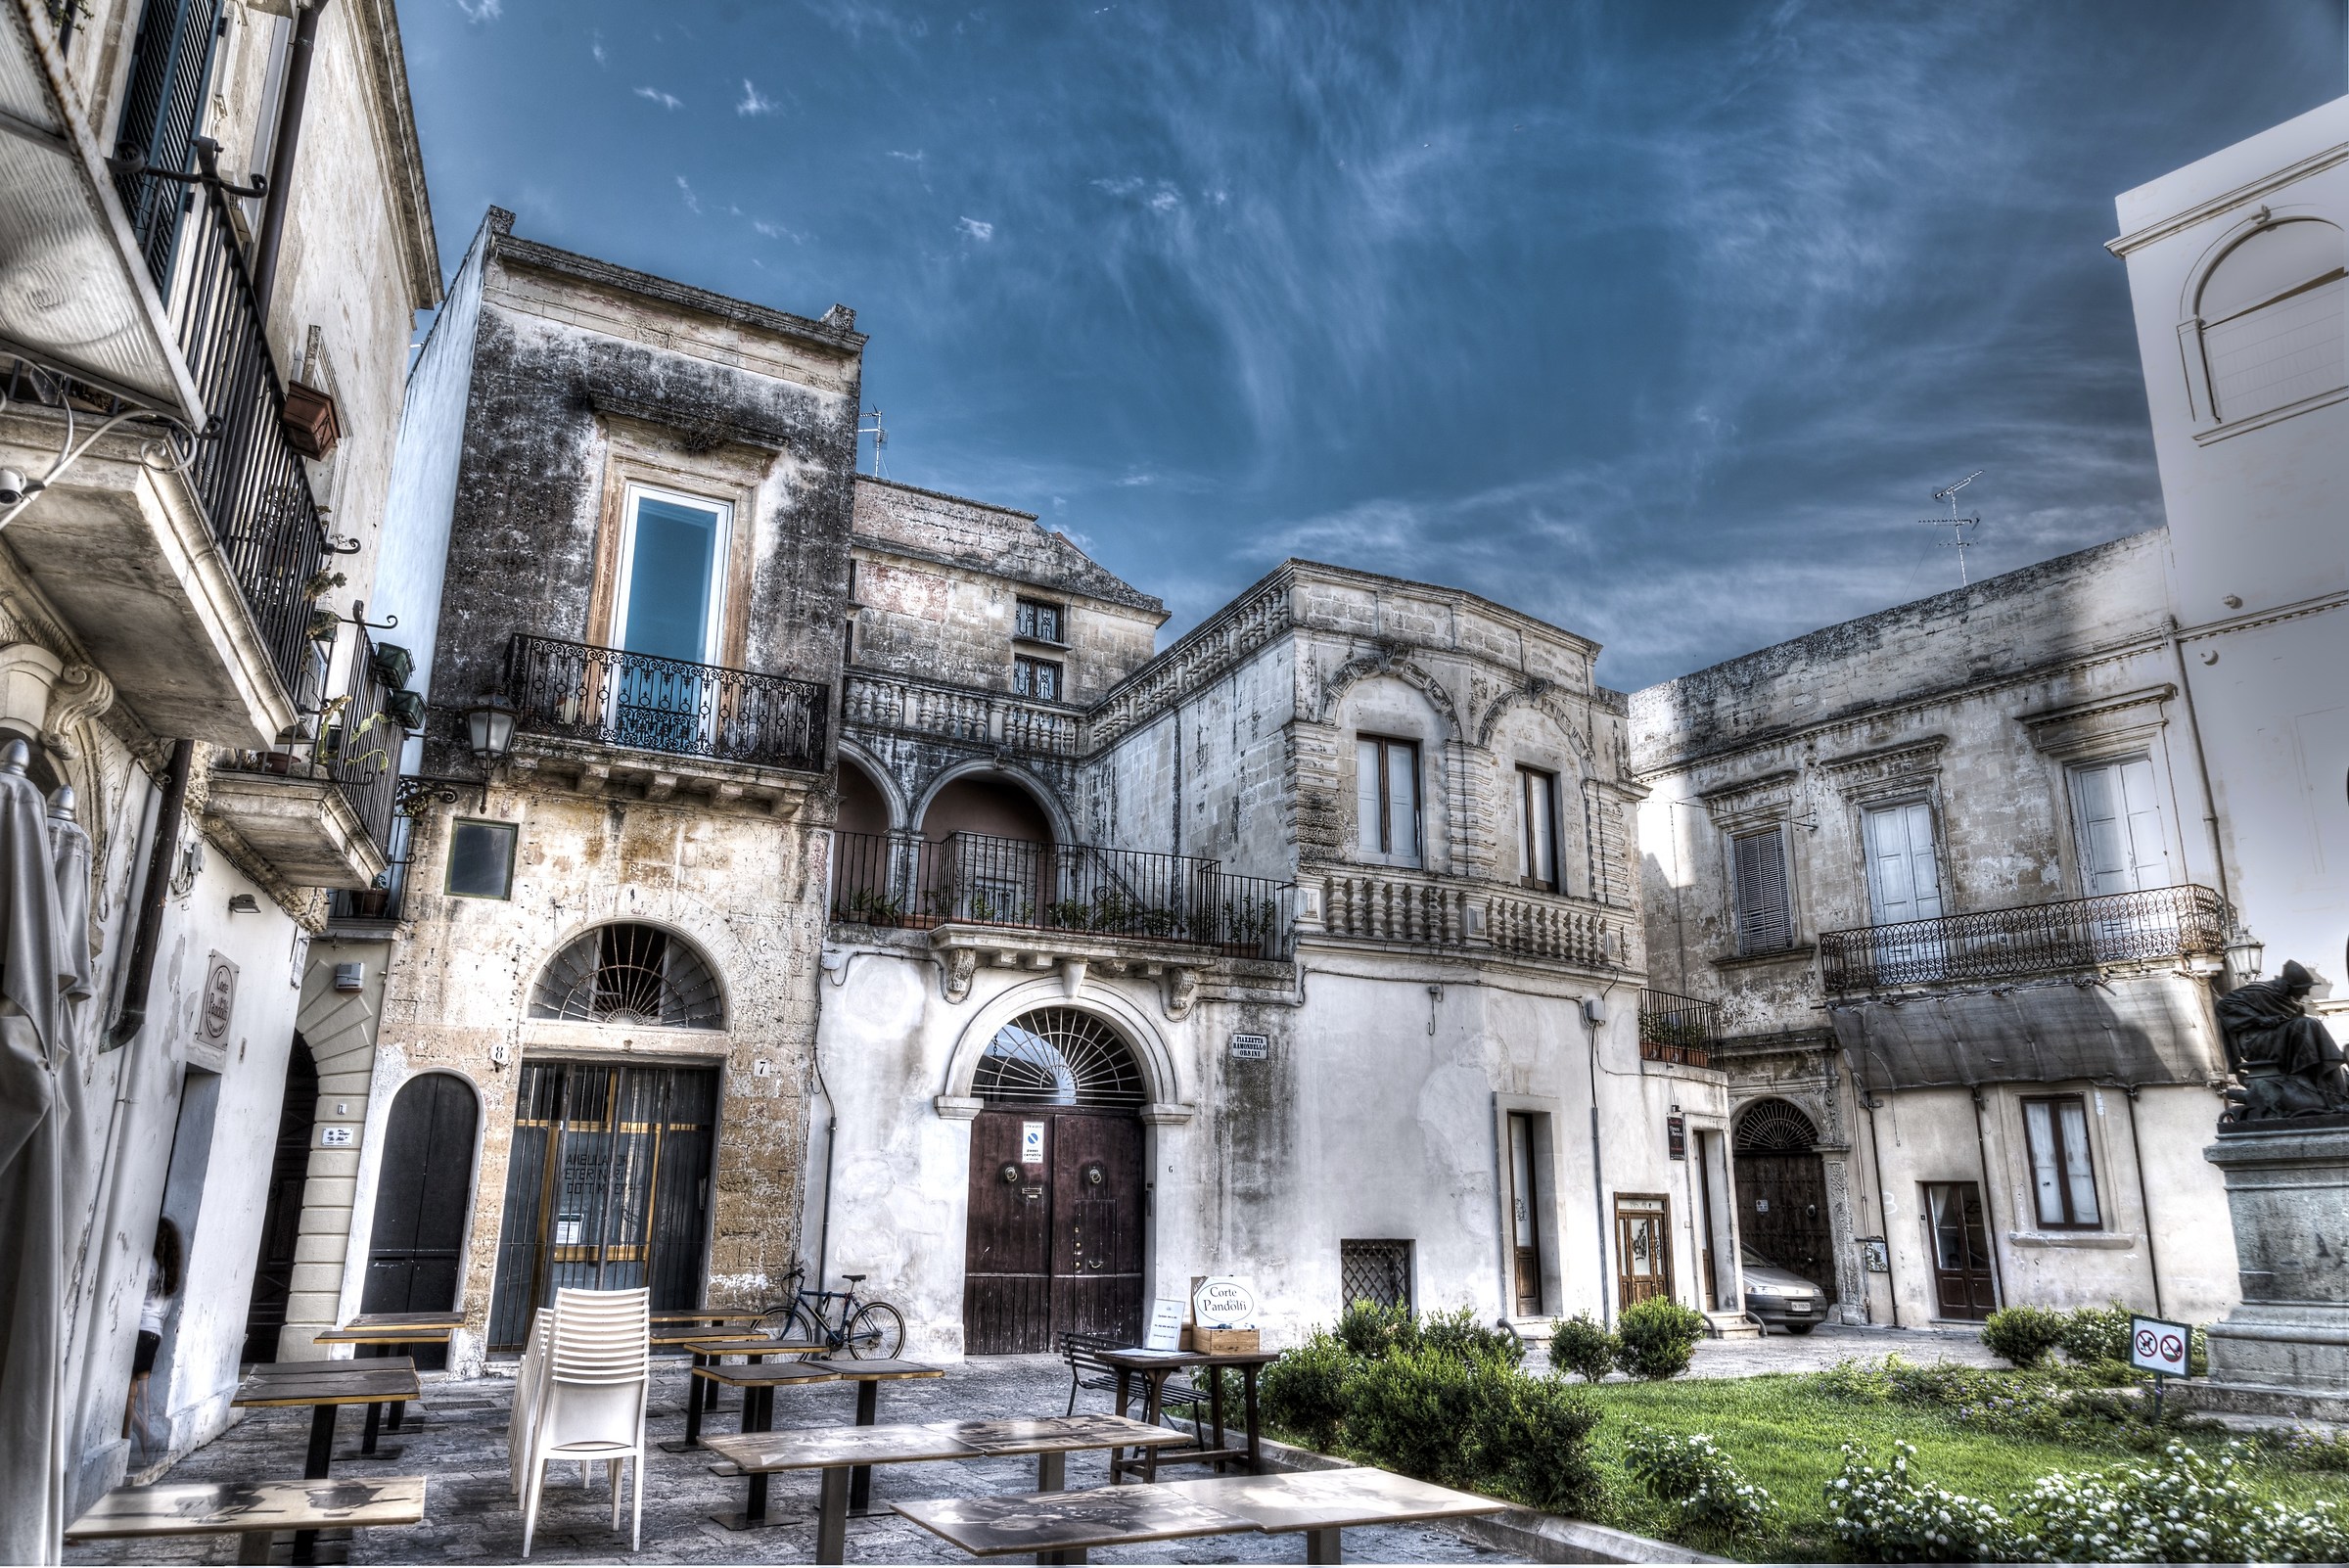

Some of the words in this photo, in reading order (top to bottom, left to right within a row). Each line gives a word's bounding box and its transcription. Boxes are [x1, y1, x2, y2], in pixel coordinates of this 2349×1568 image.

[1236, 1036, 1264, 1044] PIAZZETTA
[495, 1045, 504, 1060] 8
[760, 1061, 766, 1075] 7
[1210, 1286, 1237, 1297] Corte
[1203, 1299, 1247, 1312] Pandolfi
